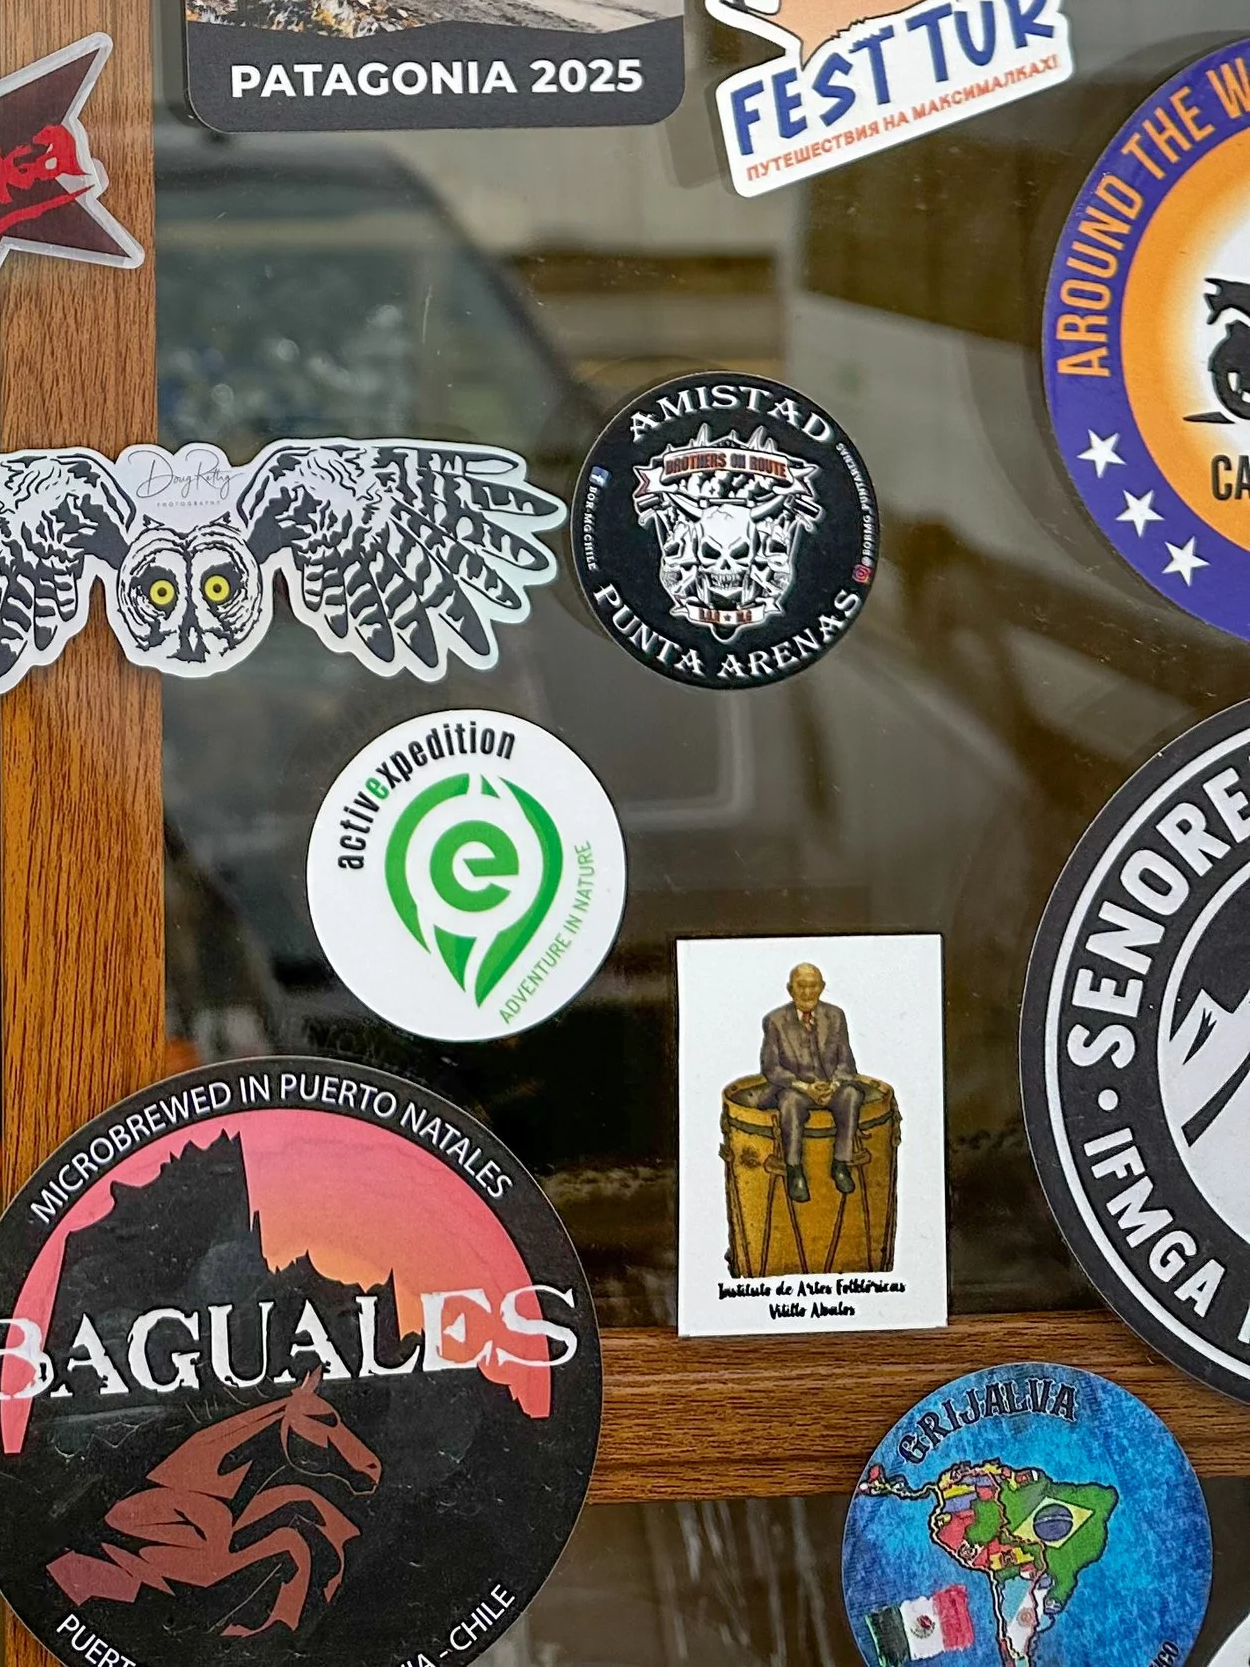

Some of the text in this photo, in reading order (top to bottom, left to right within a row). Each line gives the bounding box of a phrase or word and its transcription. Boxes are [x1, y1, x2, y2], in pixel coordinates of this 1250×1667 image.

[229, 58, 644, 100] PATAGONIA 2025
[730, 23, 895, 157] FEST
[746, 53, 1060, 182] ПУТЕШЕСТВИЯ НА МАКСИМАЛКАХ!
[1055, 172, 1143, 379] AROUND
[1120, 85, 1215, 181] THE
[628, 385, 837, 443] AMISTAD
[665, 452, 727, 475] BROTHERS
[593, 583, 863, 679] PUNTA ARENAS
[338, 721, 517, 870] activexpedition
[498, 840, 596, 1025] ADVENTURE IN NATURE
[1067, 756, 1250, 1070] SENORE
[28, 1074, 514, 1224] MICROBREWED IN PUERTO NATALES
[1083, 1126, 1227, 1321] IFMGA
[897, 1378, 1078, 1465] GRIJALVA
[449, 1583, 516, 1651] CHILE
